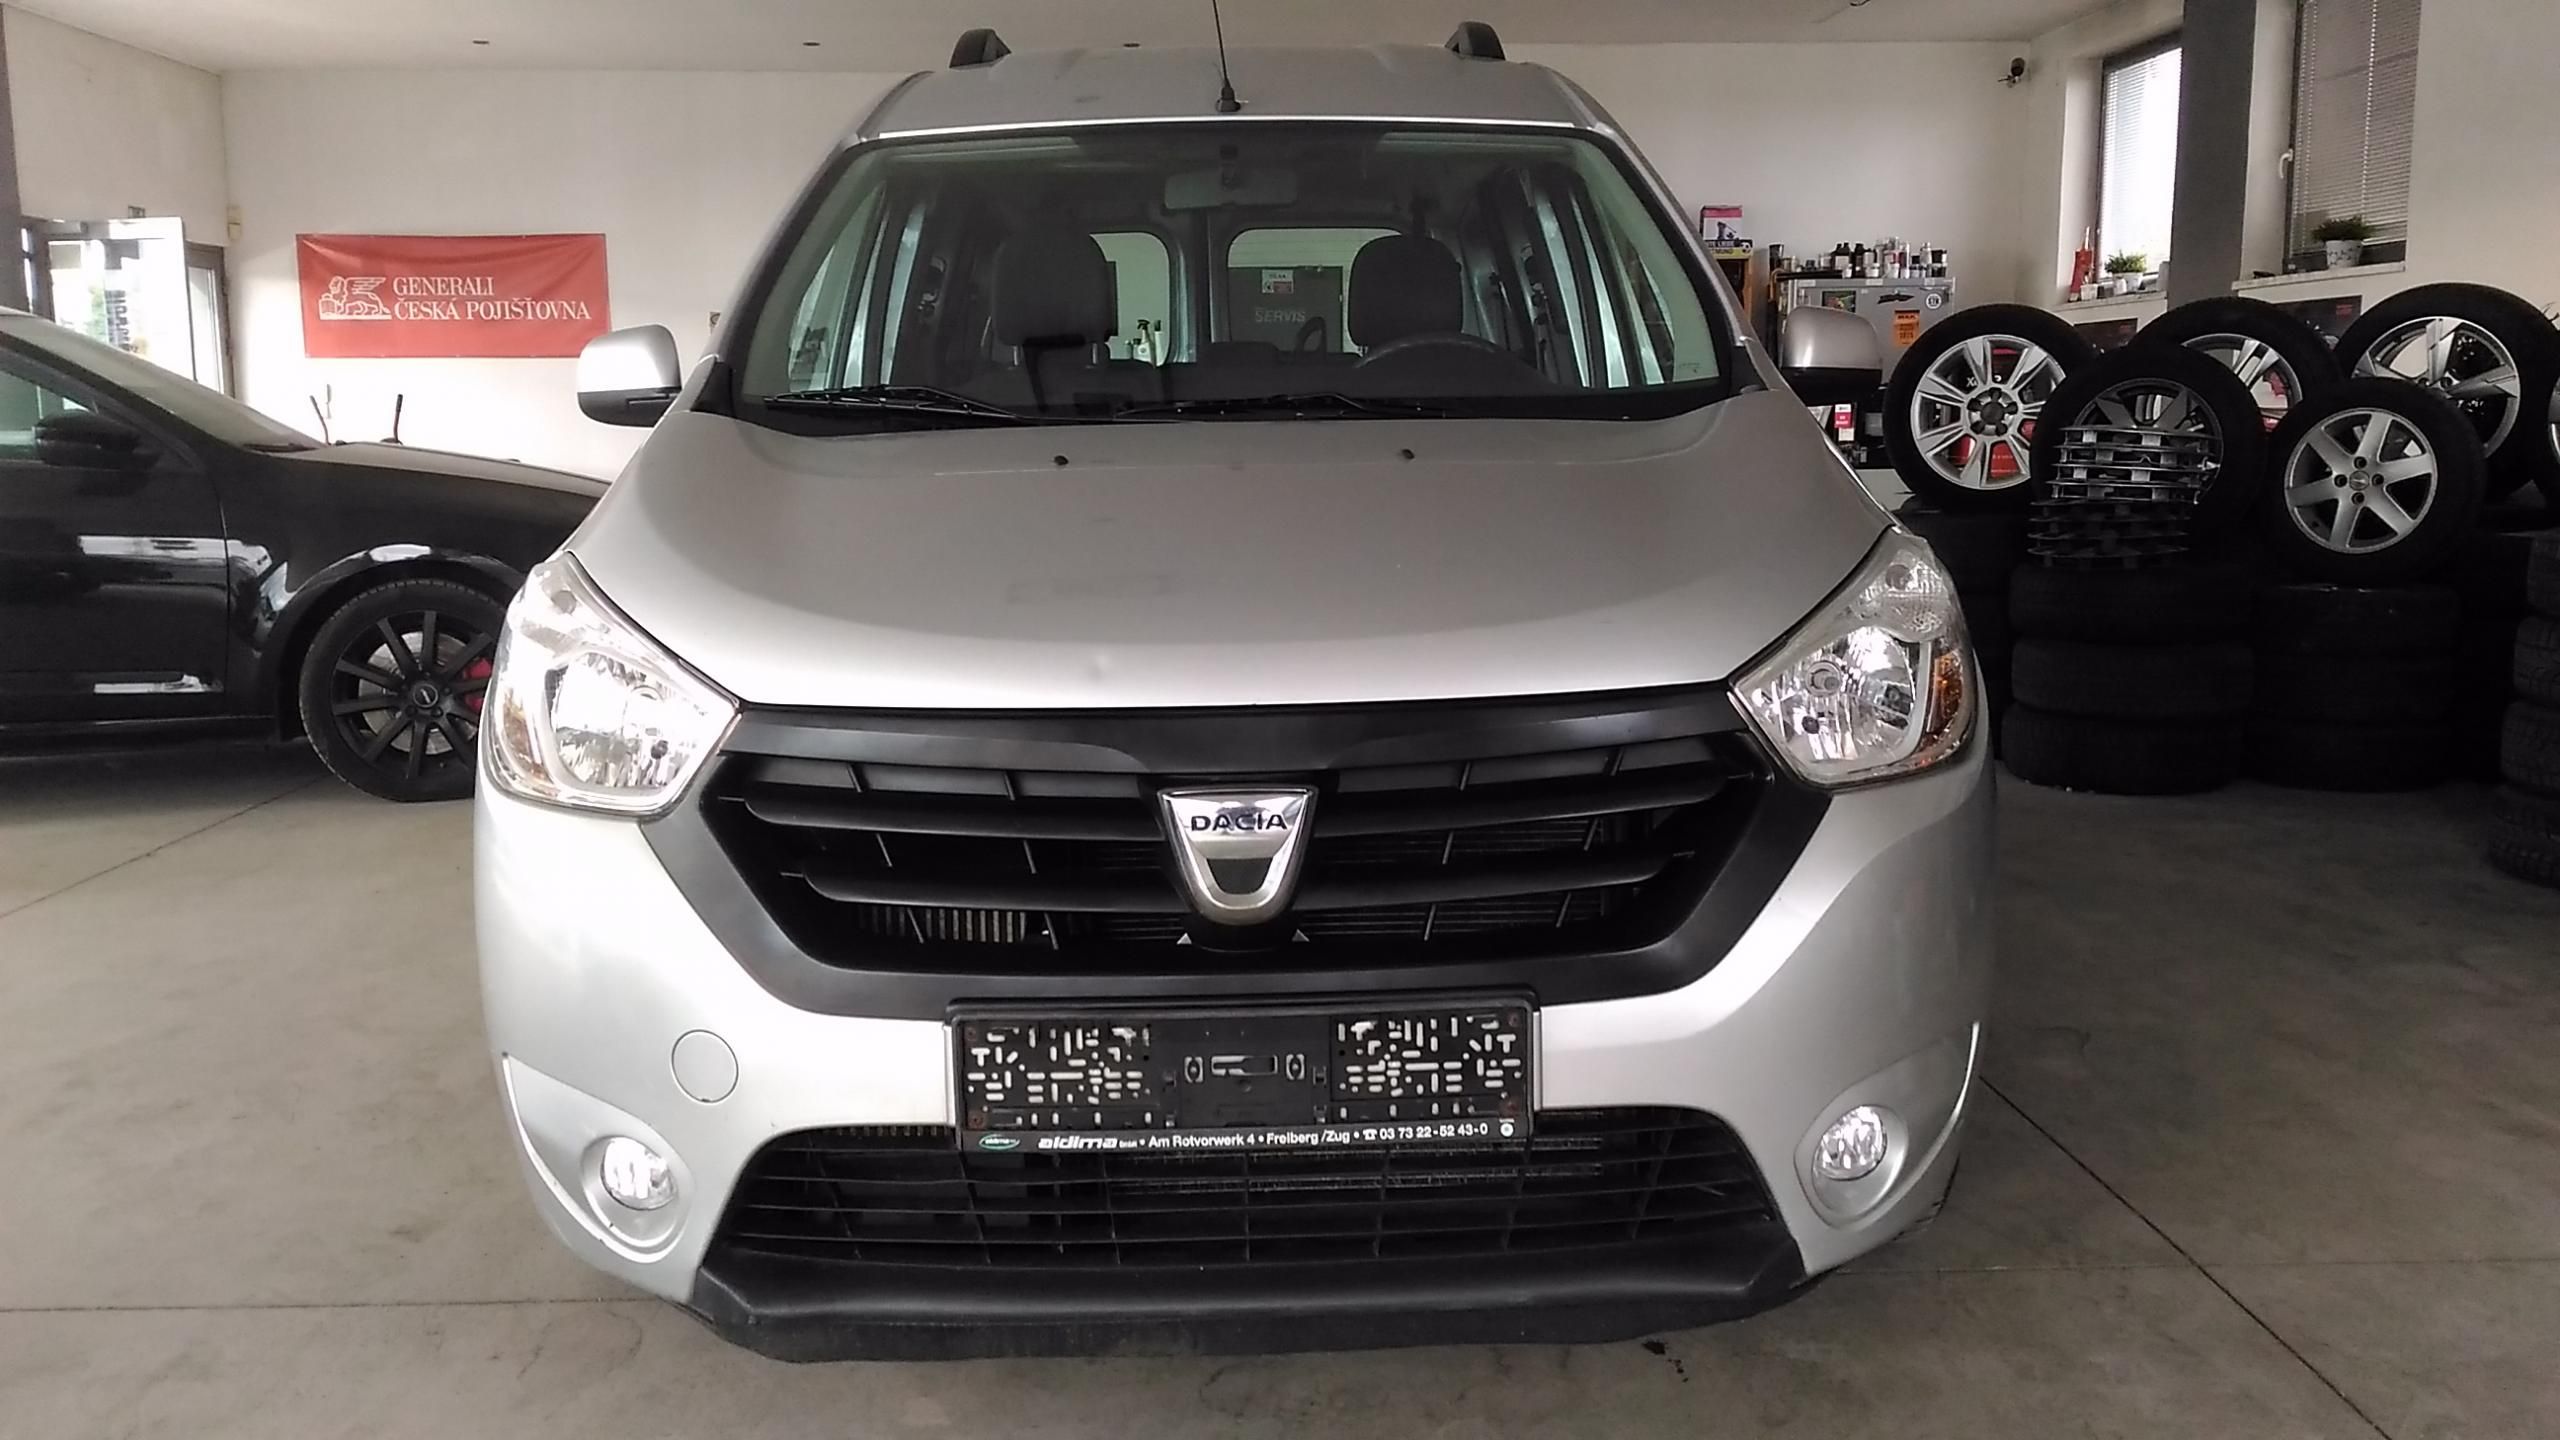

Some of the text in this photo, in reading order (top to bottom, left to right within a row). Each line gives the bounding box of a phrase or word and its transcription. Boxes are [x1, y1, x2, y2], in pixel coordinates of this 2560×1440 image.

[392, 275, 495, 297] GENERALI
[394, 296, 592, 321] ČESKÁ POJIŠŤOVNA
[1255, 309, 1306, 323] SERVIS
[1190, 813, 1288, 832] DACIA
[1038, 1135, 1119, 1150] aldima
[1148, 1135, 1170, 1148] Am
[1246, 1133, 1256, 1146] 4
[1379, 1127, 1396, 1140] 03
[1398, 1126, 1414, 1140] 73
